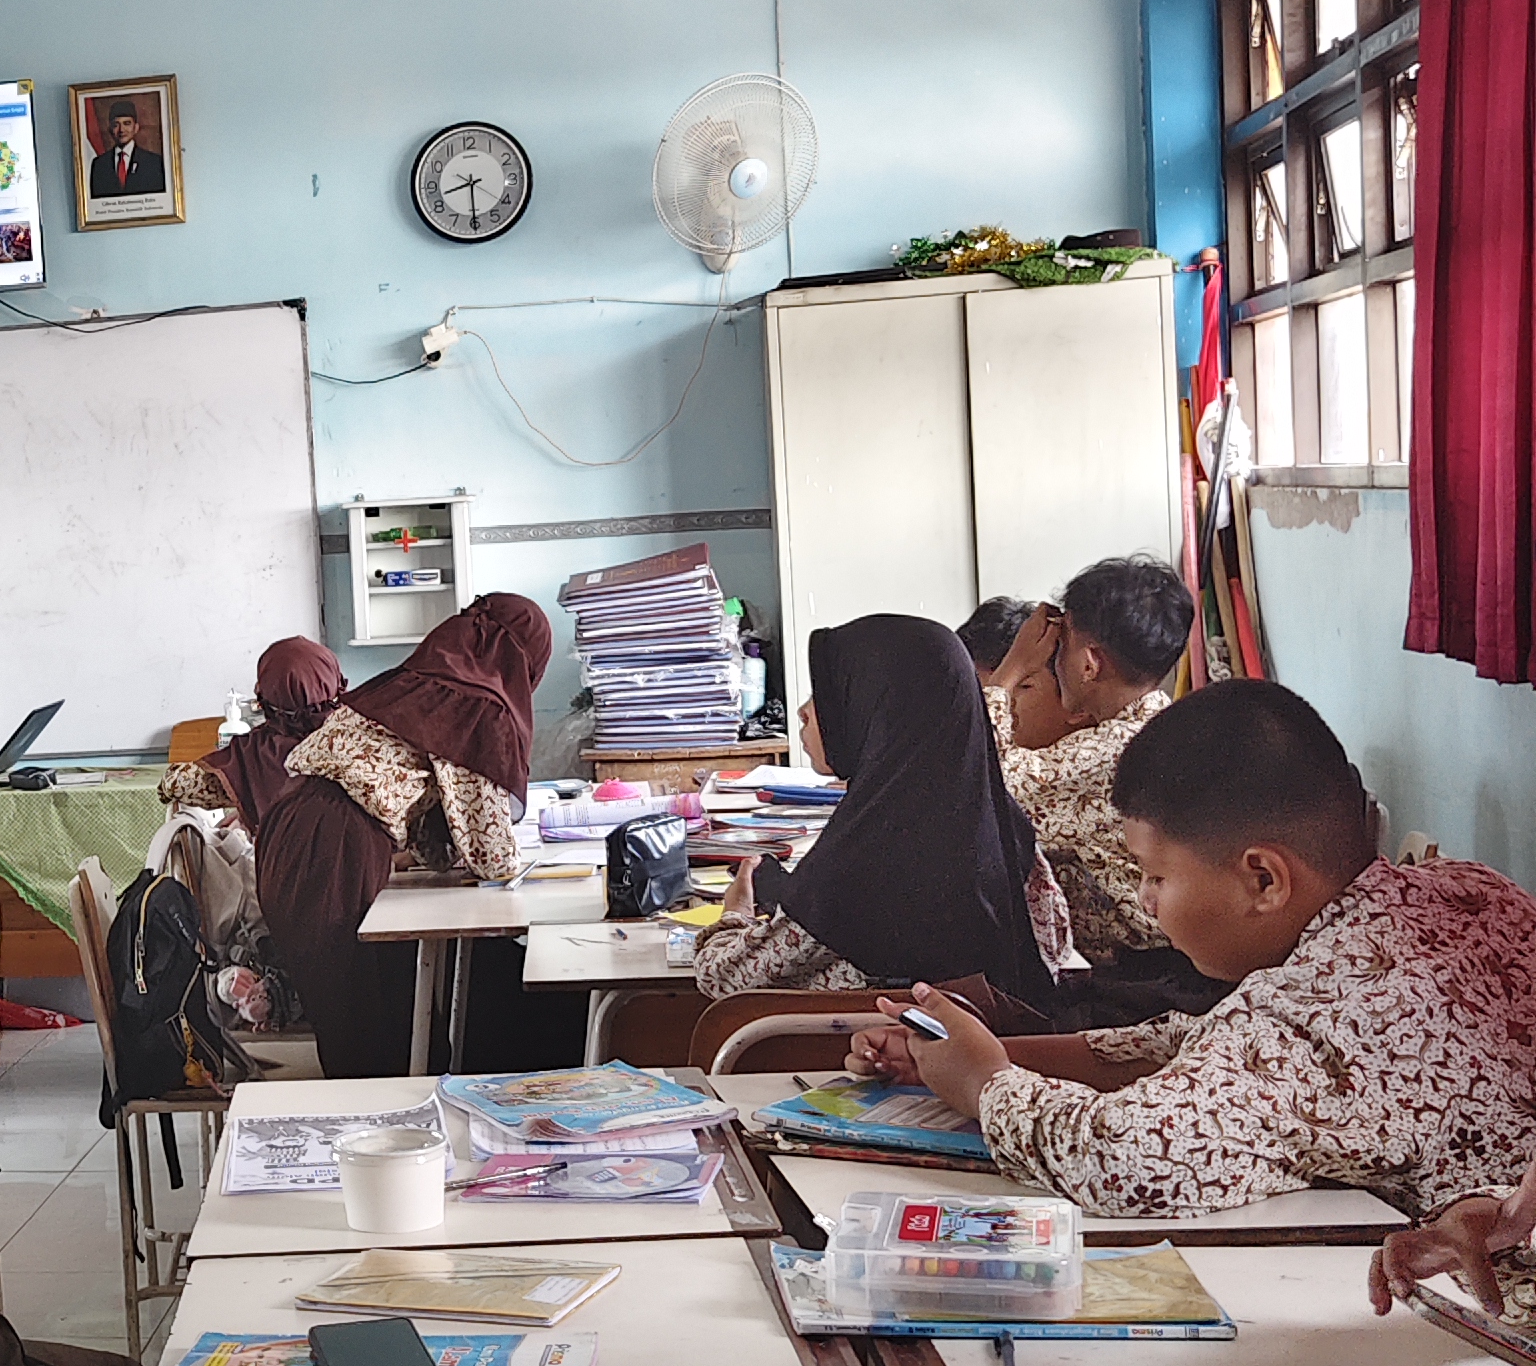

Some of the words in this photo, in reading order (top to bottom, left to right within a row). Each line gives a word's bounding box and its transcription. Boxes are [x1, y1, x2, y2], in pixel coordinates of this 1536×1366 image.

[463, 136, 476, 150] 12
[446, 144, 453, 157] 11
[501, 153, 511, 166] 2
[431, 160, 443, 173] 10
[508, 173, 518, 185] 3
[427, 181, 437, 194] 9
[501, 193, 511, 205] 4
[434, 200, 445, 213] 8
[449, 214, 459, 227] 7
[490, 210, 501, 223] 5
[1131, 1327, 1163, 1337] Prisma
